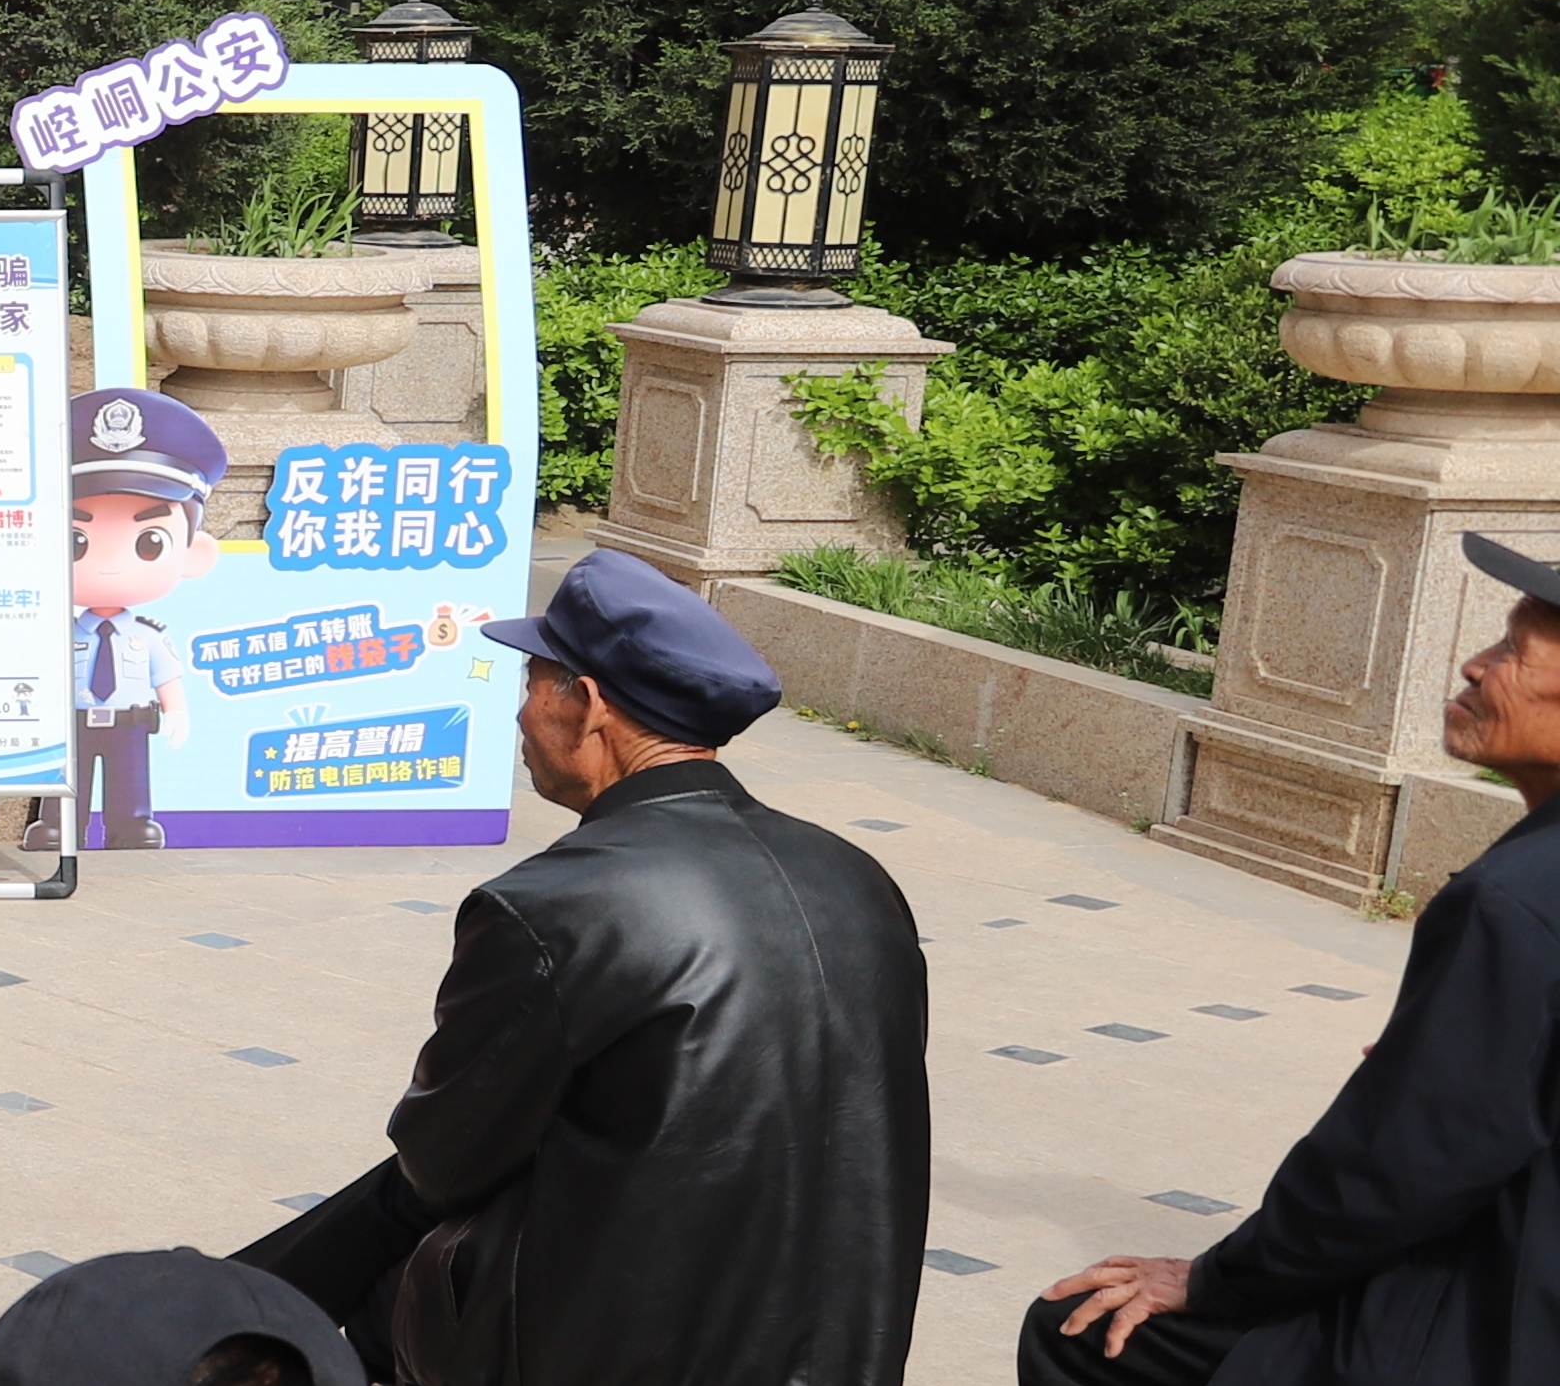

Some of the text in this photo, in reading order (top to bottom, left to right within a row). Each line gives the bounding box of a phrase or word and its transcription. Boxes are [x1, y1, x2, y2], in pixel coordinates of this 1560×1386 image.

[29, 29, 271, 158] 崆峒公安
[281, 455, 499, 505] 反诈同行
[278, 509, 494, 558] 你我同心
[199, 613, 375, 663] 不听 不信 不转账
[220, 632, 418, 688] 守好自己的钱袋子
[282, 723, 426, 763] 提高警惕
[269, 755, 462, 793] 防范电信网络诈骗
